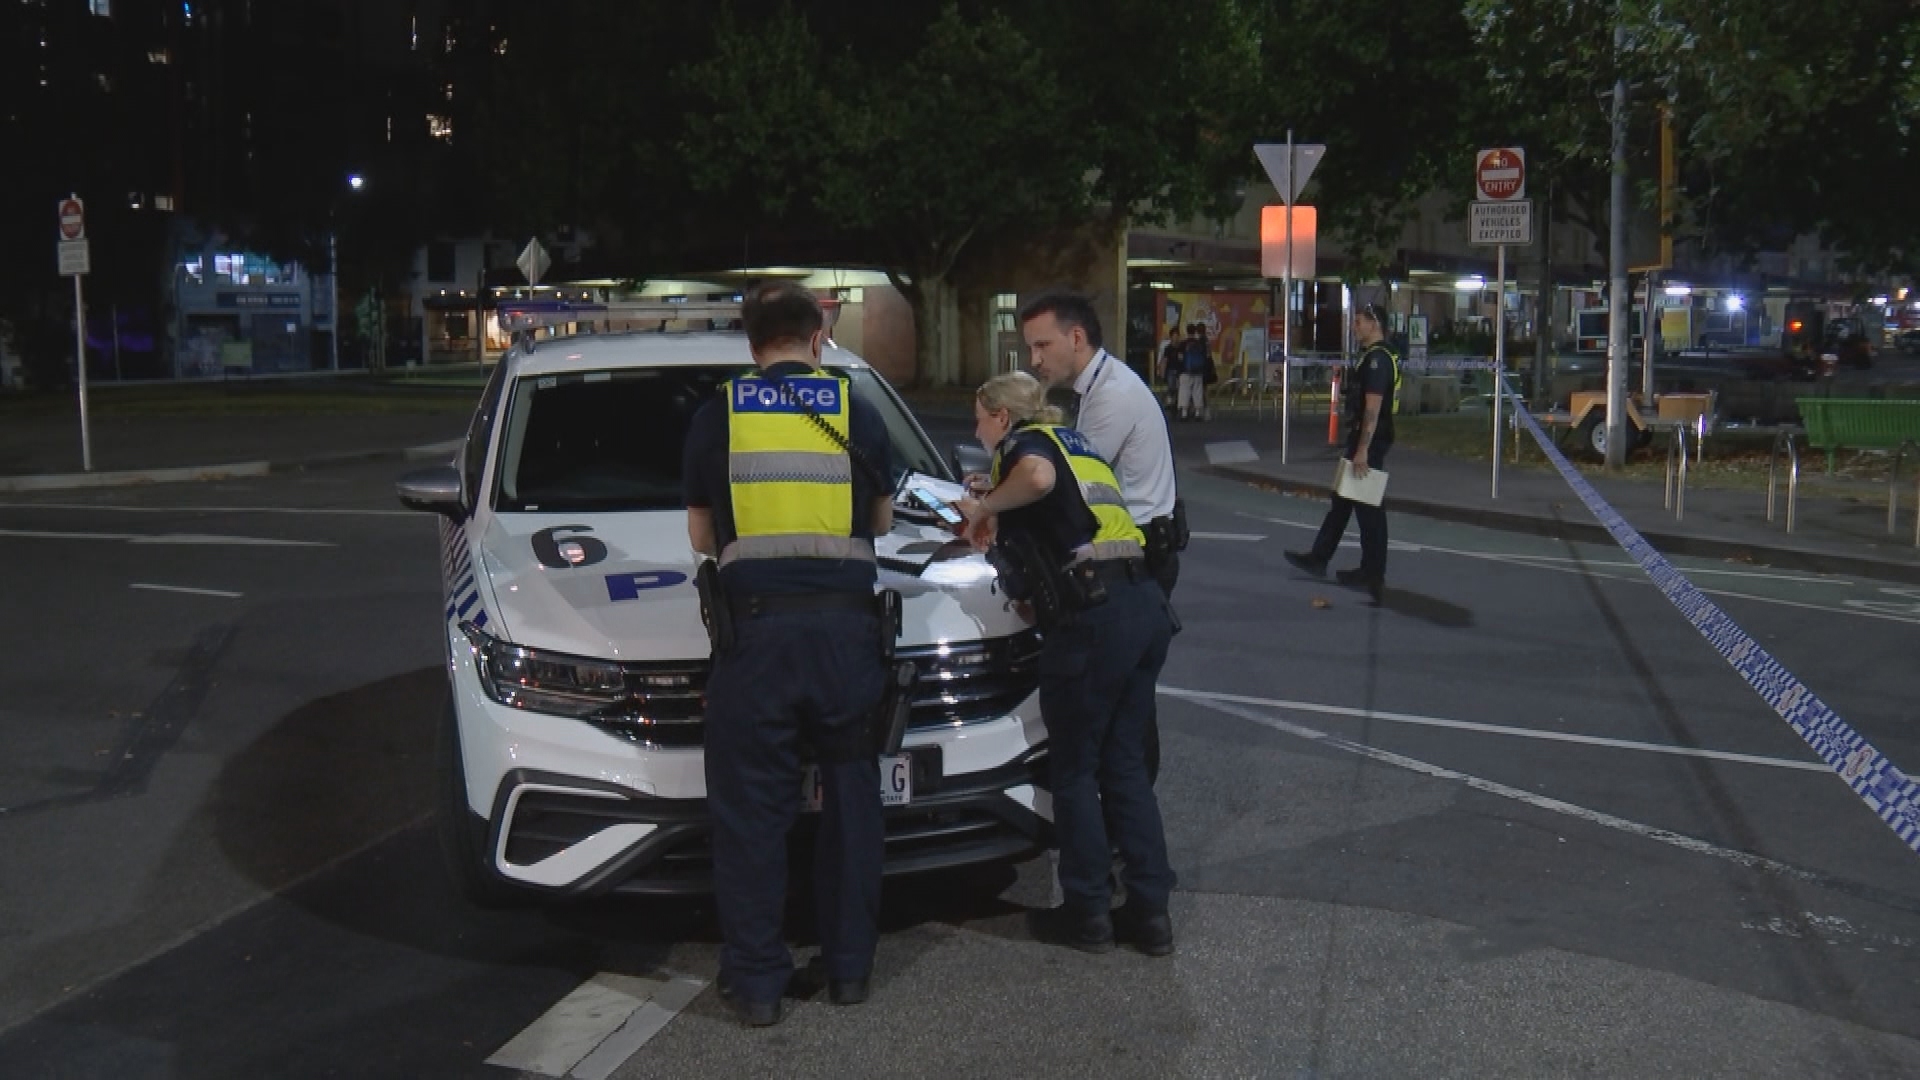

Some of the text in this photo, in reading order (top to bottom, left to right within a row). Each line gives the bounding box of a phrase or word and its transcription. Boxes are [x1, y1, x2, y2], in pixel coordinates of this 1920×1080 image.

[1484, 180, 1517, 192] ENTRY
[1475, 205, 1527, 215] AUTHORISED
[1481, 218, 1521, 227] VEHICLES
[737, 383, 836, 406] Police
[531, 525, 607, 568] 6
[605, 570, 698, 602] P
